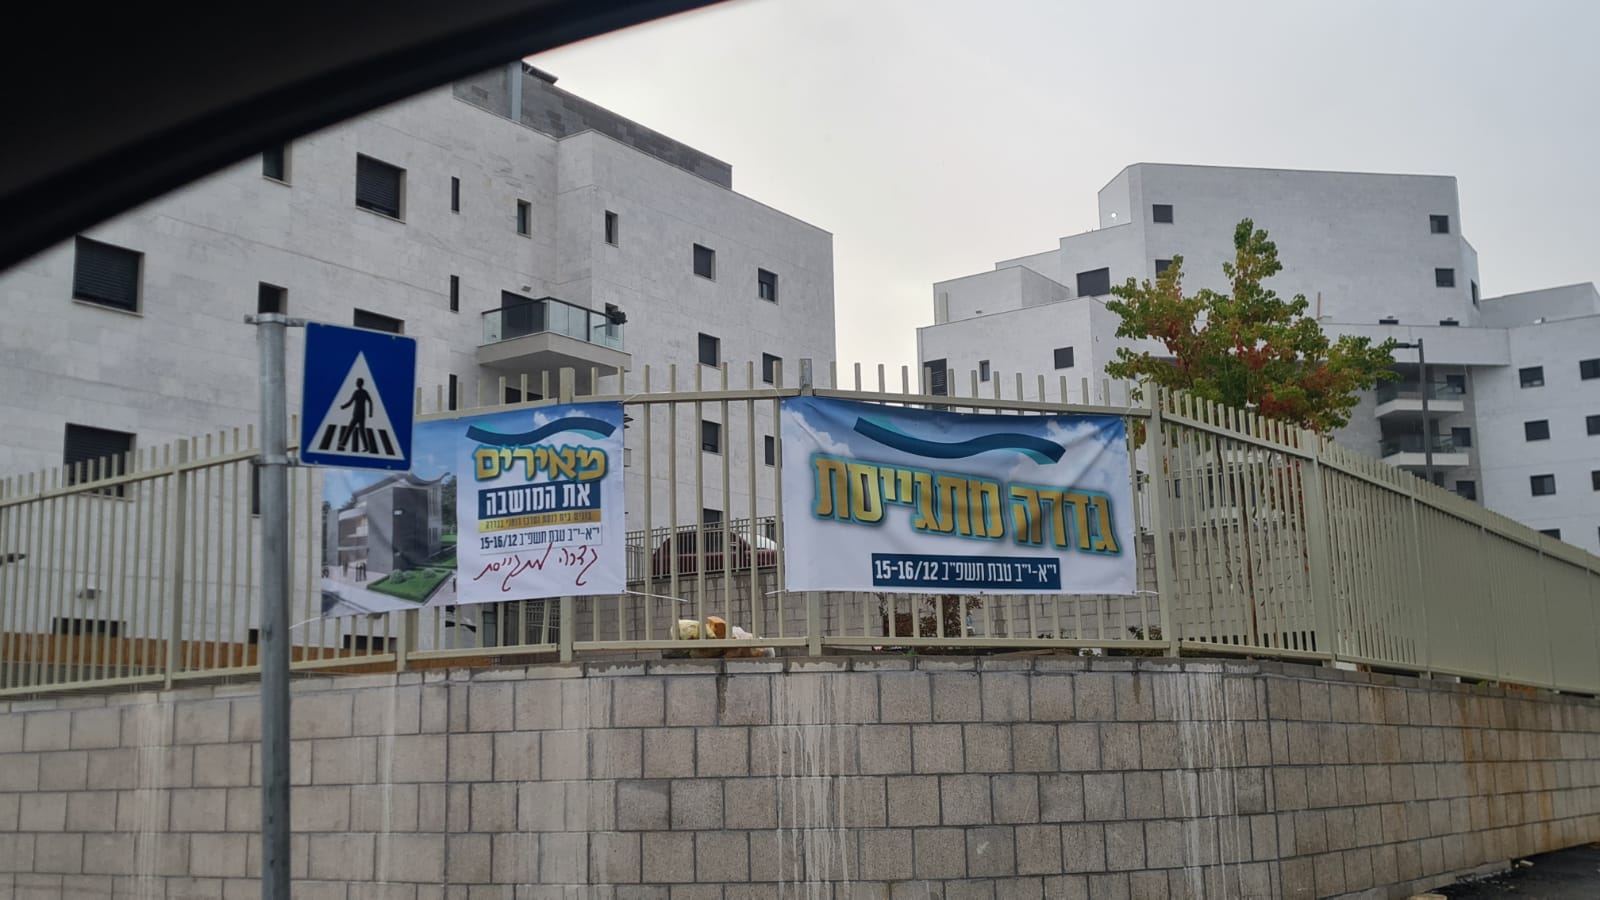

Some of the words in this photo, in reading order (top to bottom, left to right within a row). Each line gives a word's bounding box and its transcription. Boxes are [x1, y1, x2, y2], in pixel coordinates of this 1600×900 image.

[474, 445, 607, 481] מאירים
[486, 485, 556, 516] המושבה
[562, 483, 590, 508] את
[812, 455, 1005, 539] מתגייסת
[1010, 483, 1121, 555] גדרה
[480, 534, 517, 550] 15-16/12
[519, 531, 547, 546] תשפ"ב
[549, 529, 565, 543] טבת
[473, 542, 553, 592] מתגייסת
[558, 544, 598, 586] גדרה
[875, 560, 938, 581] 15-16/12
[941, 561, 985, 582] תשפ"ב
[988, 562, 1012, 582] טבת
